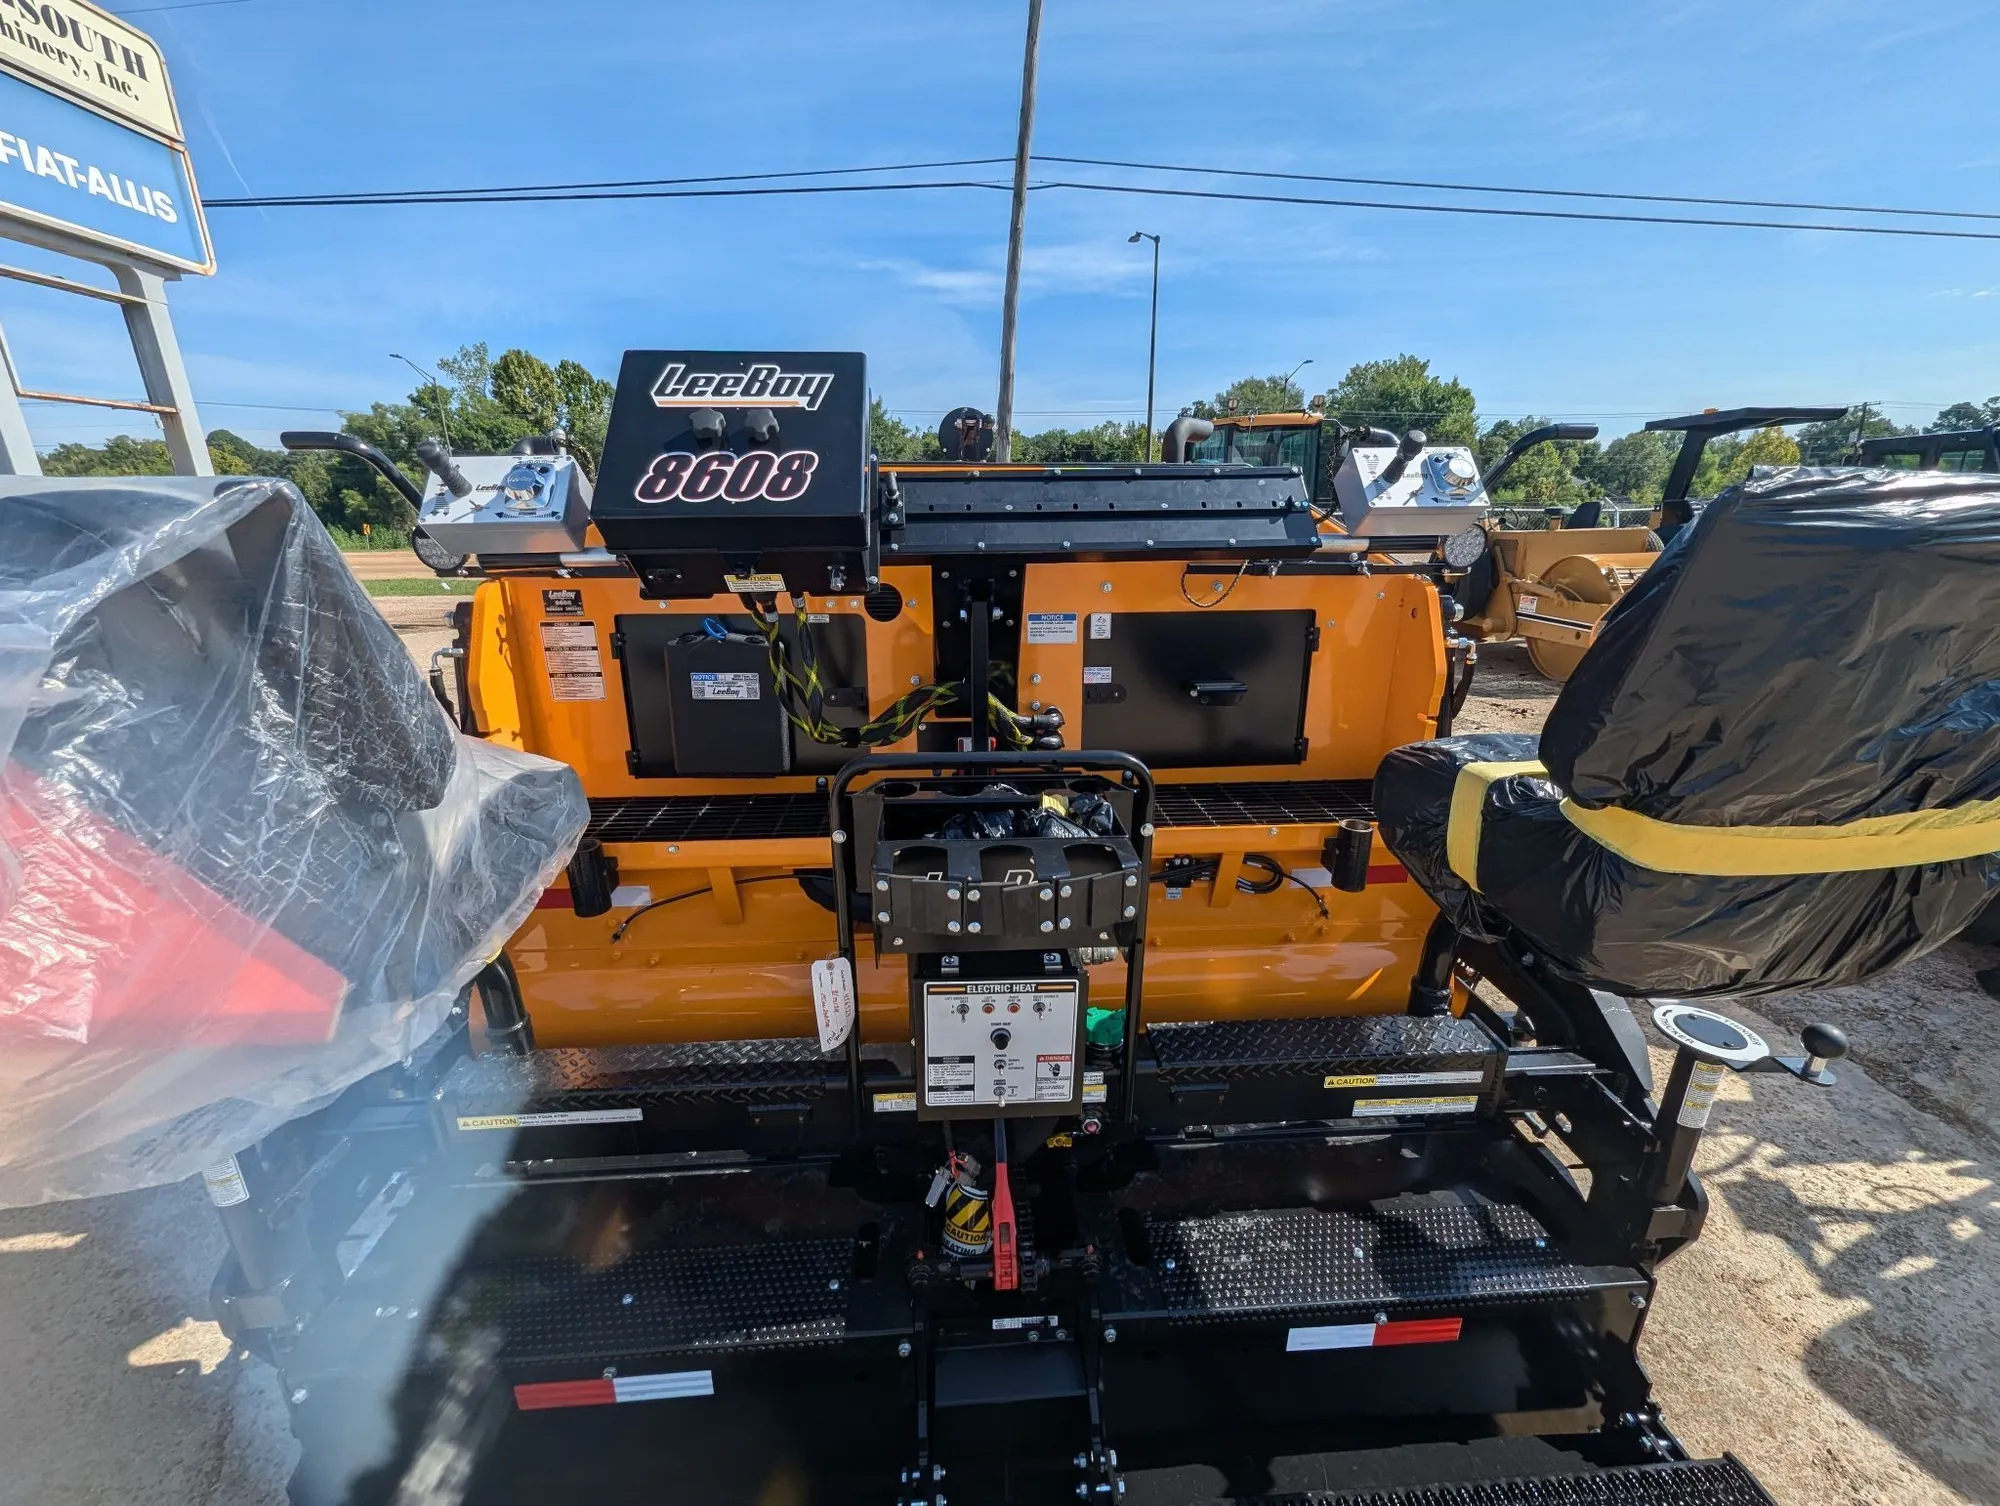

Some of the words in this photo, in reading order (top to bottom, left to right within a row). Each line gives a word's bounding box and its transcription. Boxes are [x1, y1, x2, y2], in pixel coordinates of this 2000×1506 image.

[2, 0, 149, 82] SOUTH
[94, 60, 139, 101] Inc.
[0, 131, 177, 224] FIAT-ALLIS
[651, 364, 834, 410] LeeBoy
[635, 451, 819, 502] 8608
[549, 590, 576, 600] LeeBoy
[712, 688, 739, 698] LeeBoy
[967, 985, 1011, 993] ELECTRIC
[1013, 984, 1037, 992] HEAT
[1661, 1018, 1694, 1044] THICKER
[1725, 1019, 1761, 1046] THINNER
[1337, 1077, 1375, 1086] CAUTION
[472, 1117, 517, 1127] CAUTION
